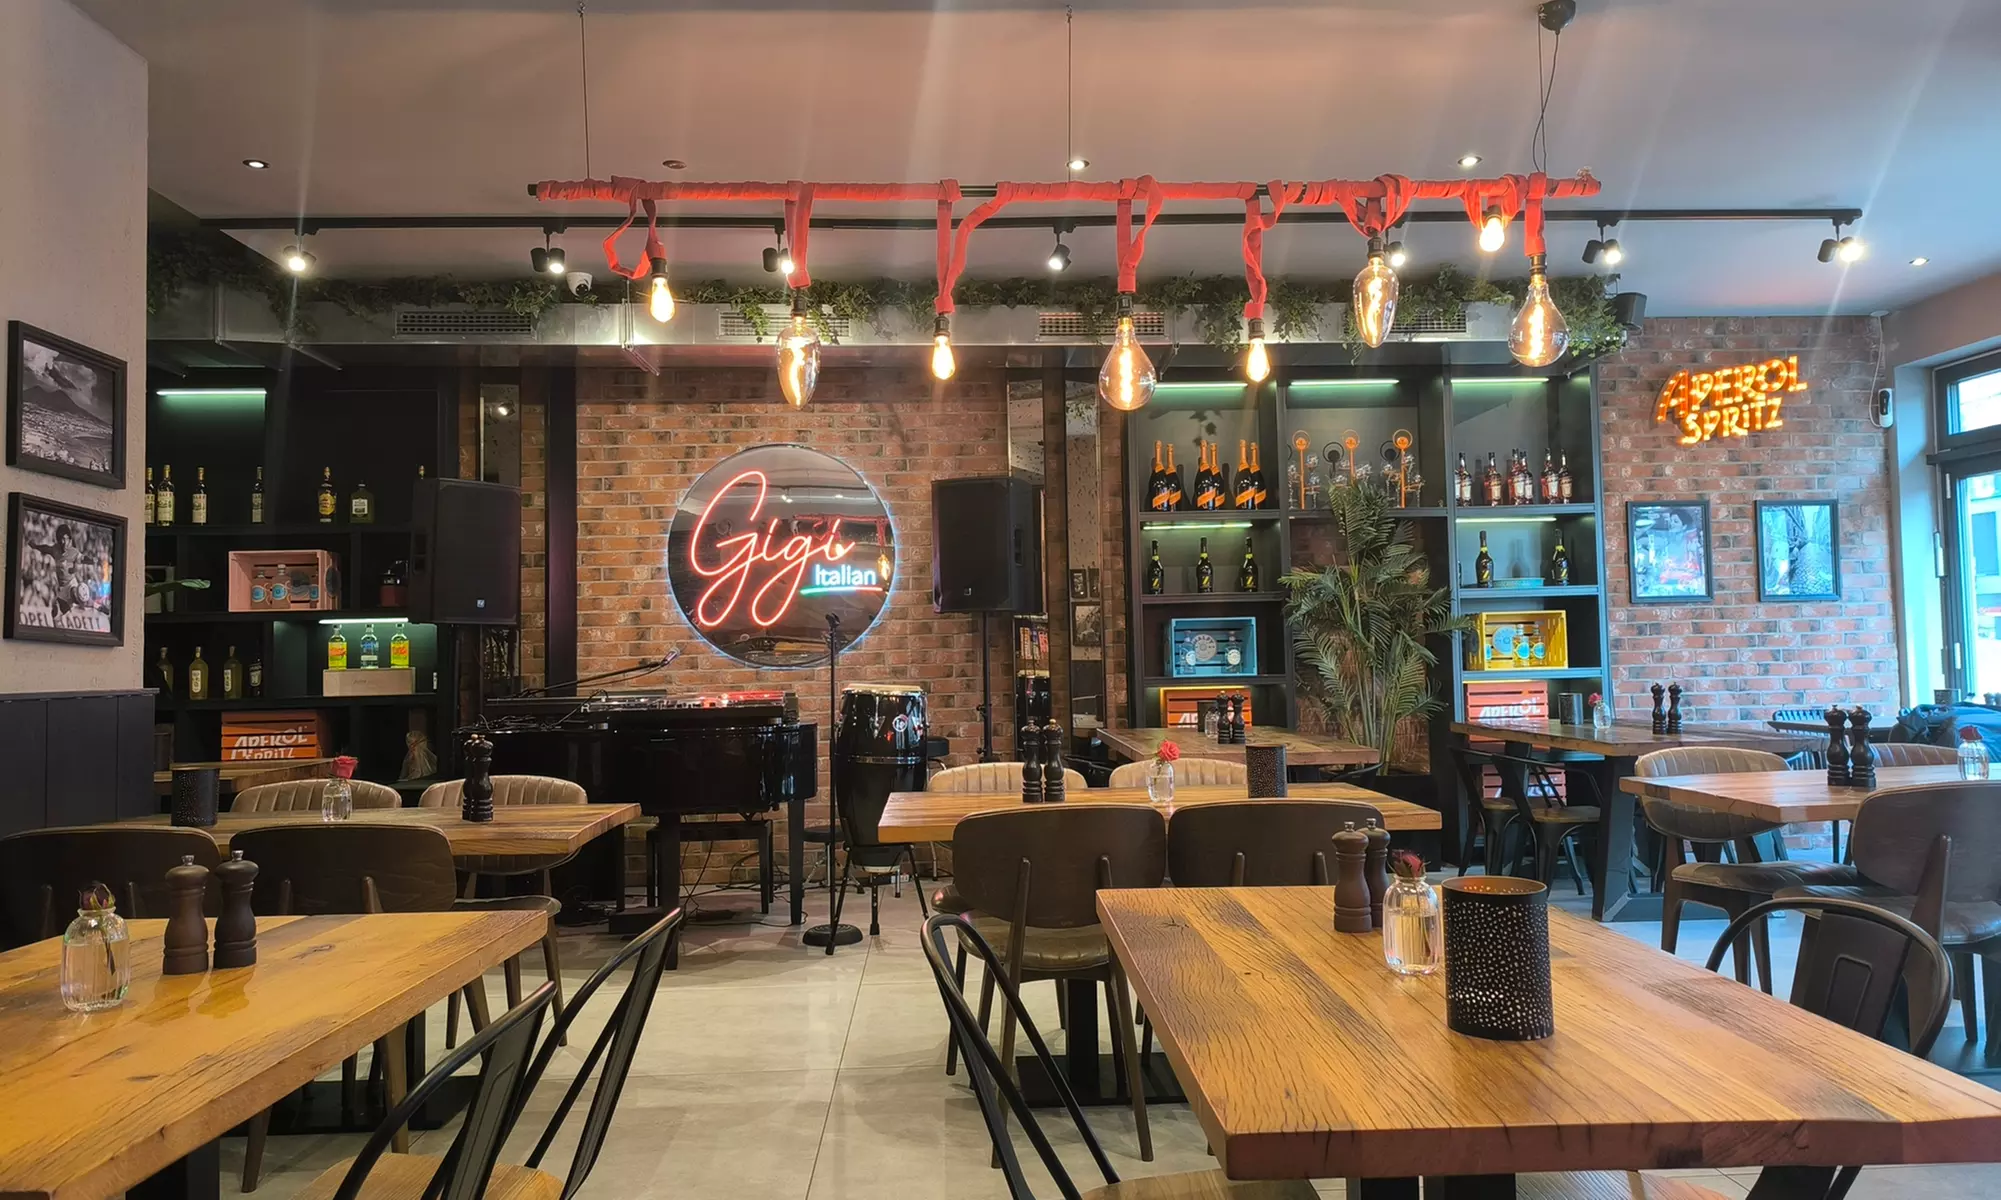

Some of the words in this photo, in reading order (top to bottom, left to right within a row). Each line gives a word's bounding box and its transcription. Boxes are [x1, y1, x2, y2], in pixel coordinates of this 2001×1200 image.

[1655, 355, 1808, 423] APEROL
[691, 470, 855, 626] Gigi
[814, 564, 877, 586] Italian
